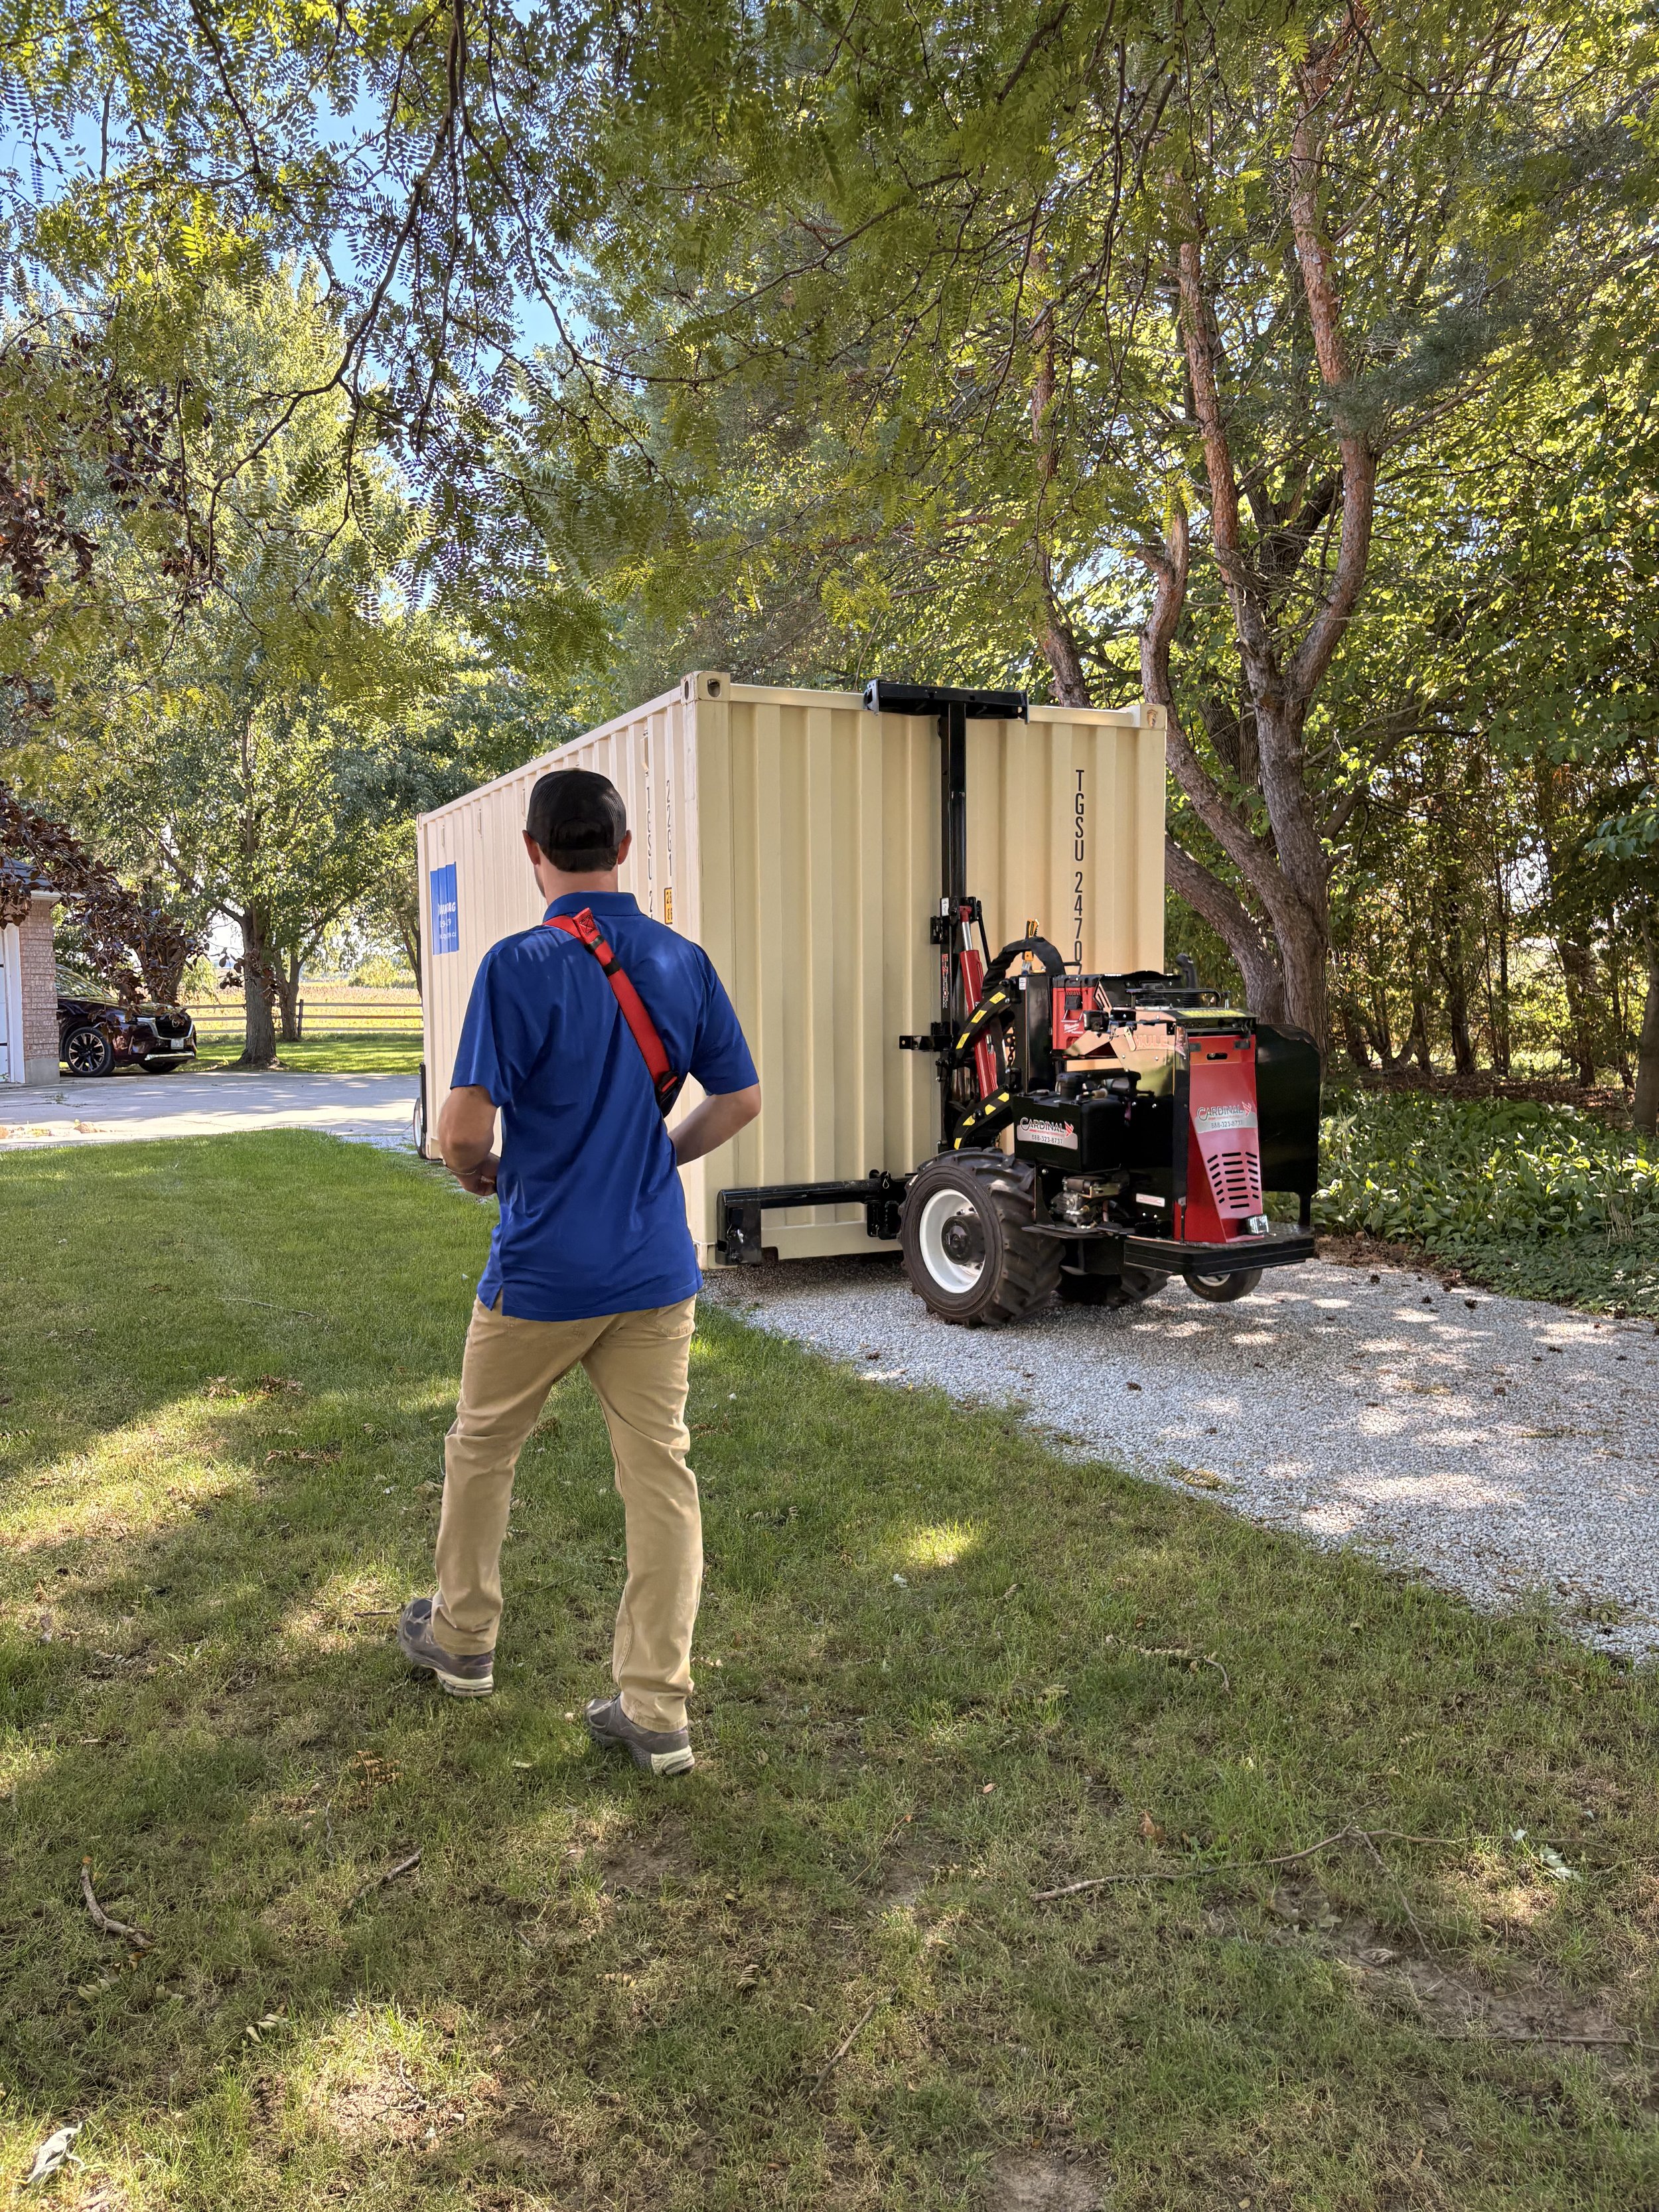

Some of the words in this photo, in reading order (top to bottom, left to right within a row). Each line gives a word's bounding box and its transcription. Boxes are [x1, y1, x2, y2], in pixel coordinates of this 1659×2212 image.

[1074, 769, 1085, 861] TGSU
[1133, 1035, 1169, 1048] MULE
[1196, 1104, 1243, 1122] CARDINAL
[1019, 1116, 1064, 1134] CARDINAL
